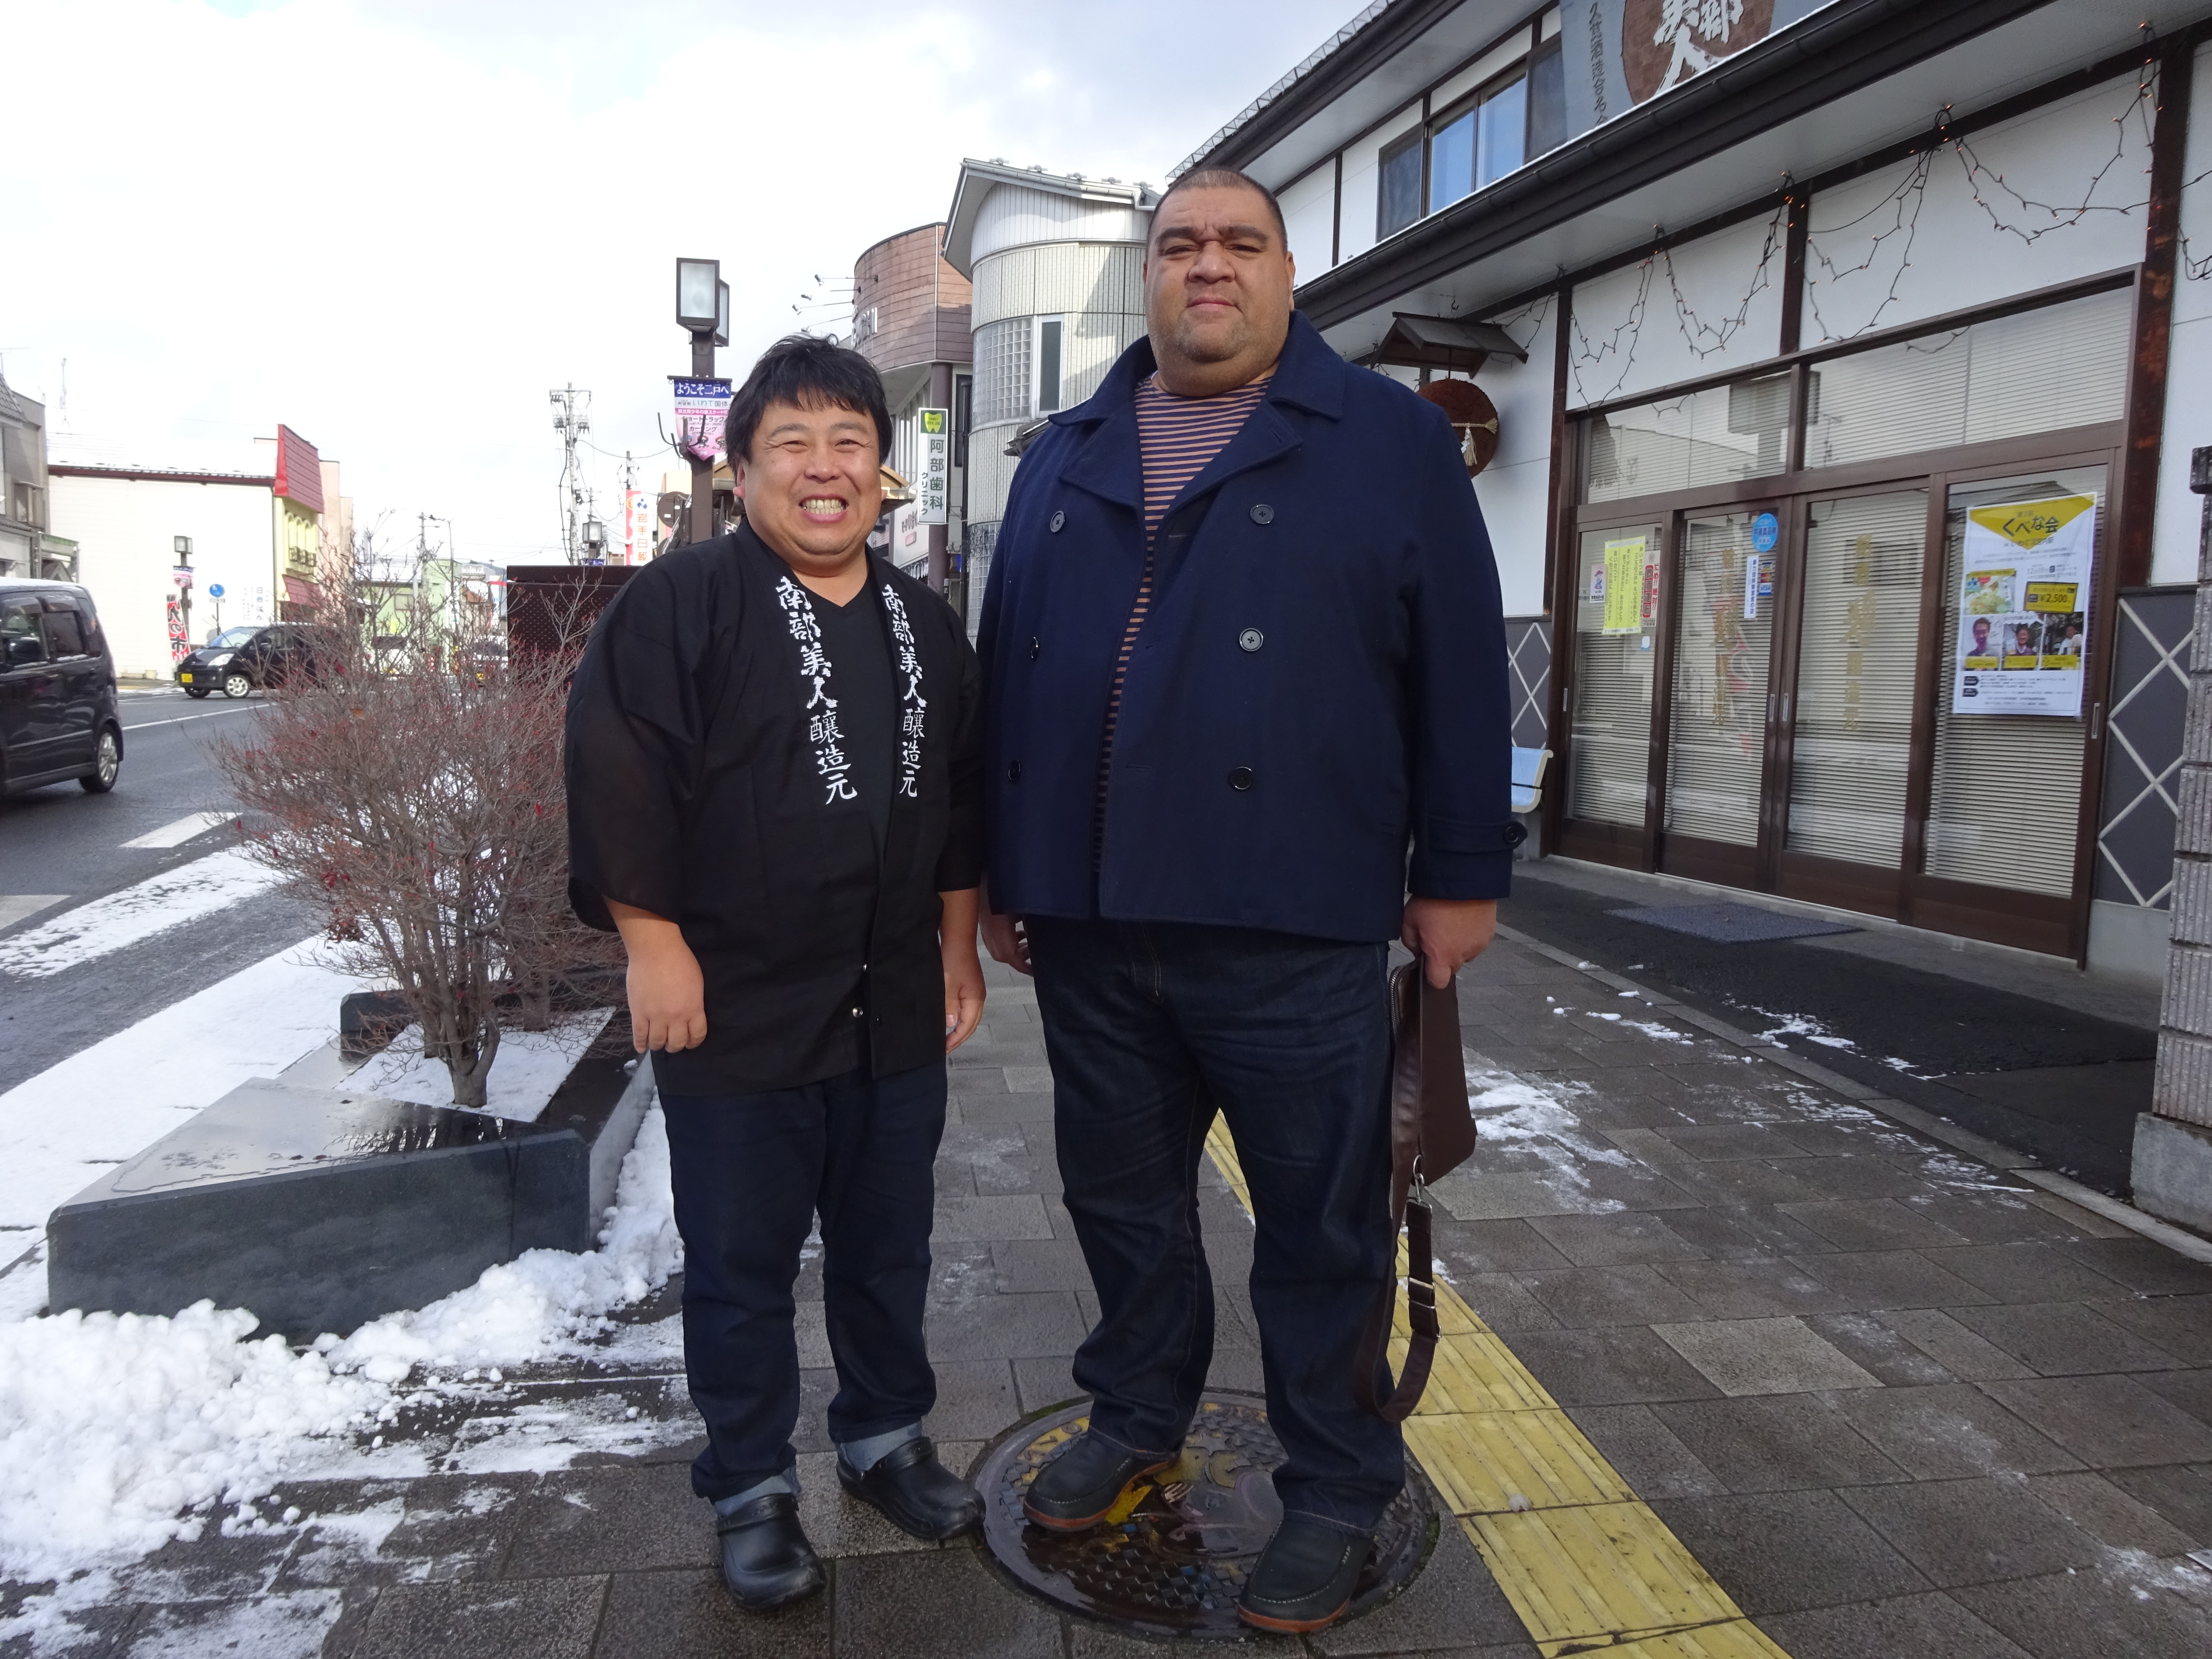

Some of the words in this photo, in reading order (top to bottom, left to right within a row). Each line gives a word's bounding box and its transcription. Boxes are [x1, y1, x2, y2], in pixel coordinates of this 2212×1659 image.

[677, 382, 729, 396] ようこそ二戸へ
[930, 439, 945, 510] 阿部歯科
[637, 512, 648, 562] 岩手日報
